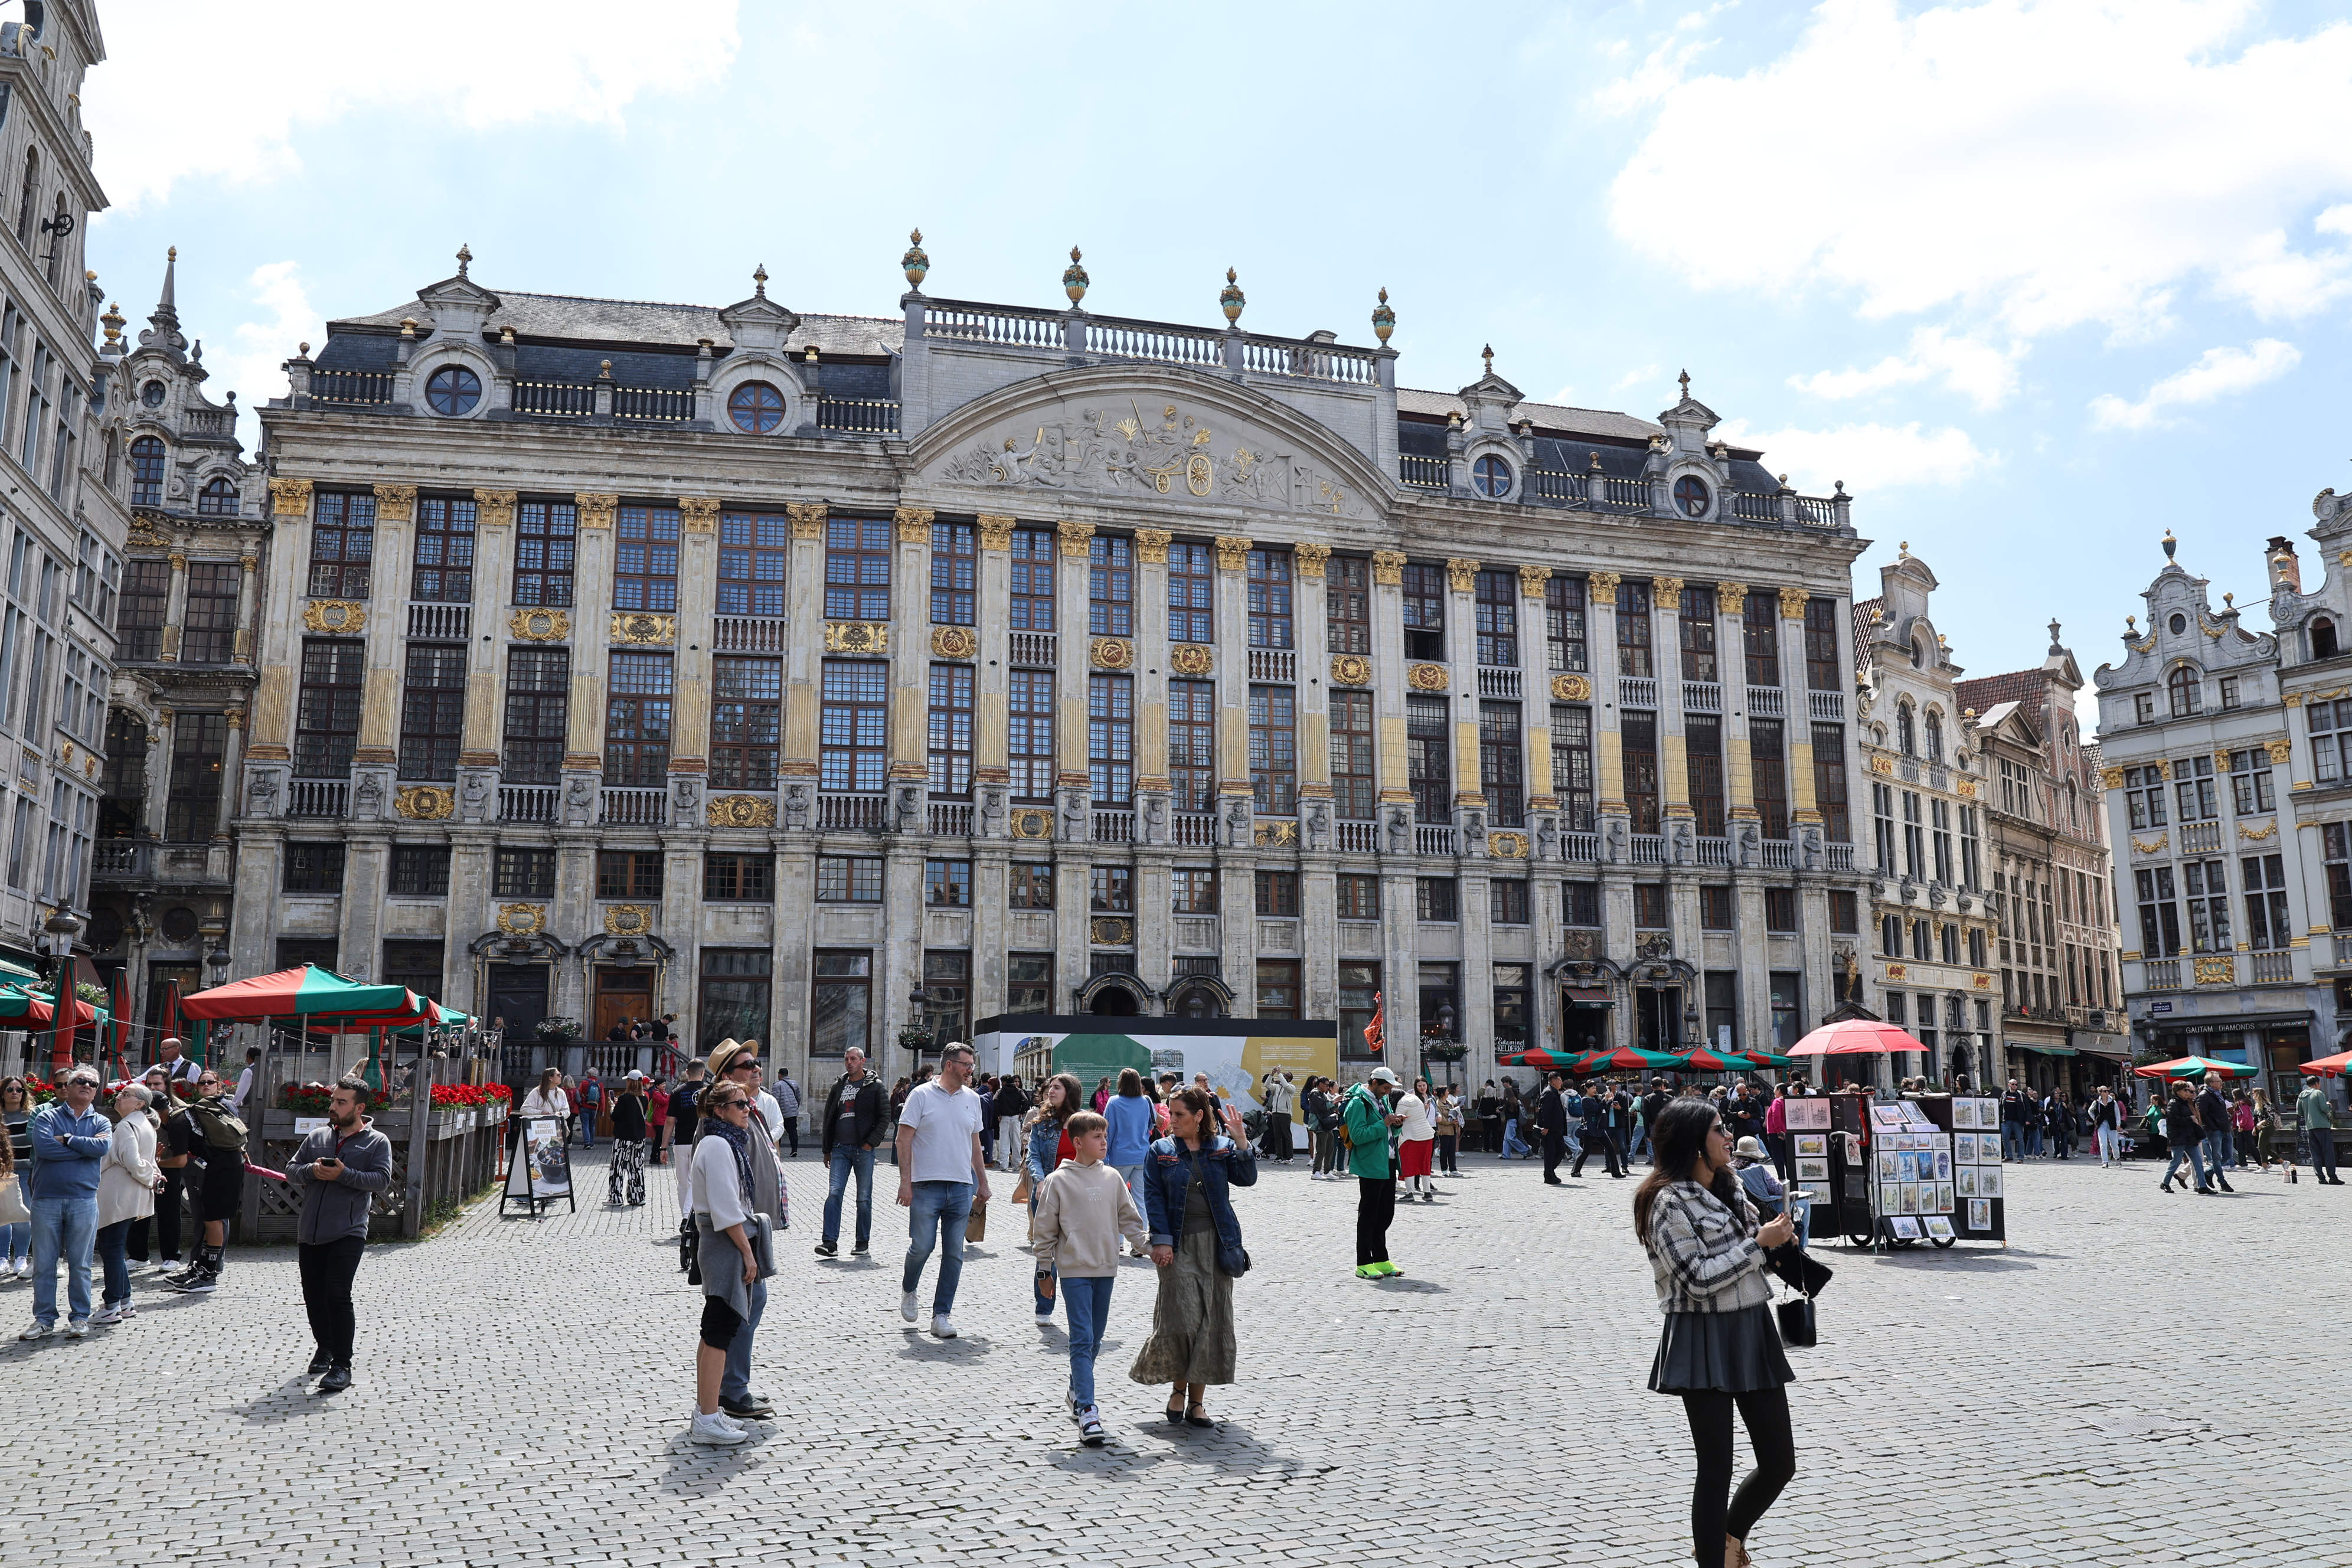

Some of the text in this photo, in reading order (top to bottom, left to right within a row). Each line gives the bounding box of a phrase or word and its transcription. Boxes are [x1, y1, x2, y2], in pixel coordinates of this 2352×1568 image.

[325, 612, 346, 621] ANNO
[530, 620, 550, 630] 1698
[1342, 999, 1368, 1007] Banking
[2219, 1023, 2255, 1032] DIAMONDS
[842, 1084, 861, 1092] Rea
